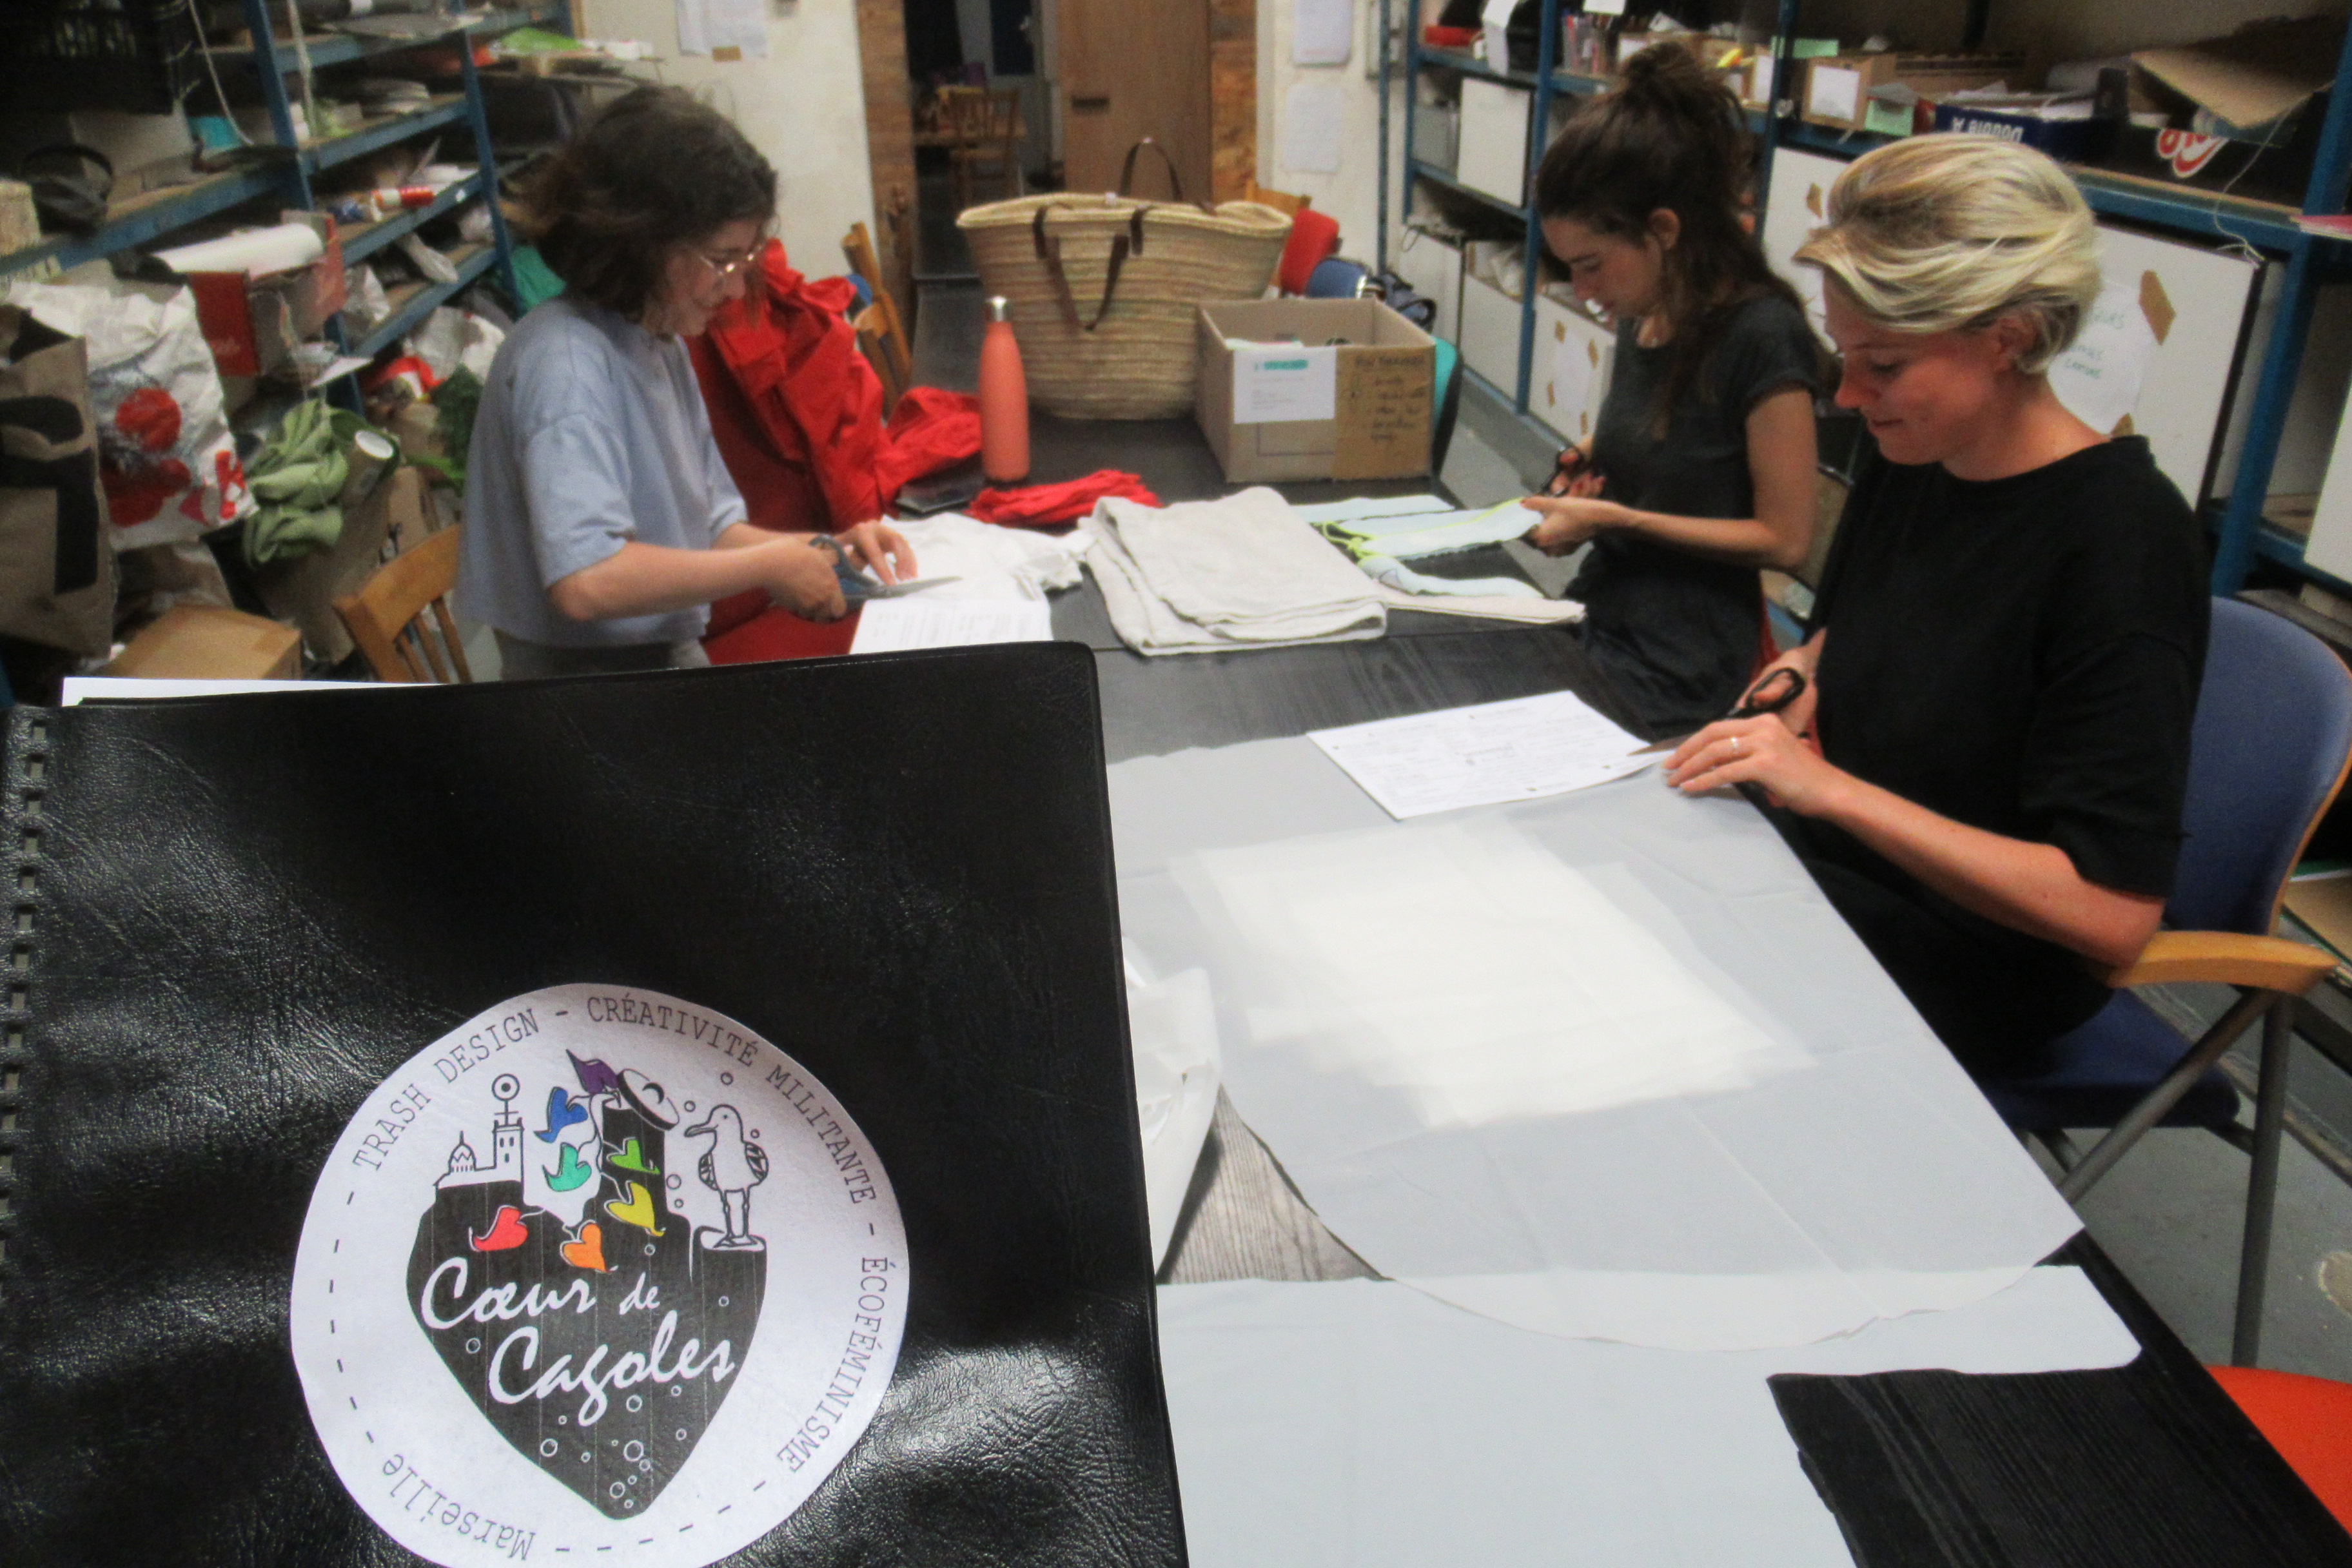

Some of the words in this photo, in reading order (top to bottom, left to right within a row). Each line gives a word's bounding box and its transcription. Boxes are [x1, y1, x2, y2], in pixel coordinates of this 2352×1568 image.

[433, 1007, 541, 1084] DESIGN
[587, 993, 759, 1068] CRÉATIVITÉ
[352, 1083, 431, 1171] TRASH
[766, 1064, 876, 1204] MILITANTE
[420, 1257, 596, 1330] Cœur
[619, 1272, 661, 1315] de
[488, 1309, 735, 1427] Cagoles
[776, 1257, 896, 1473] ÉCOFÉMINISME
[382, 1453, 536, 1561] Marseille
